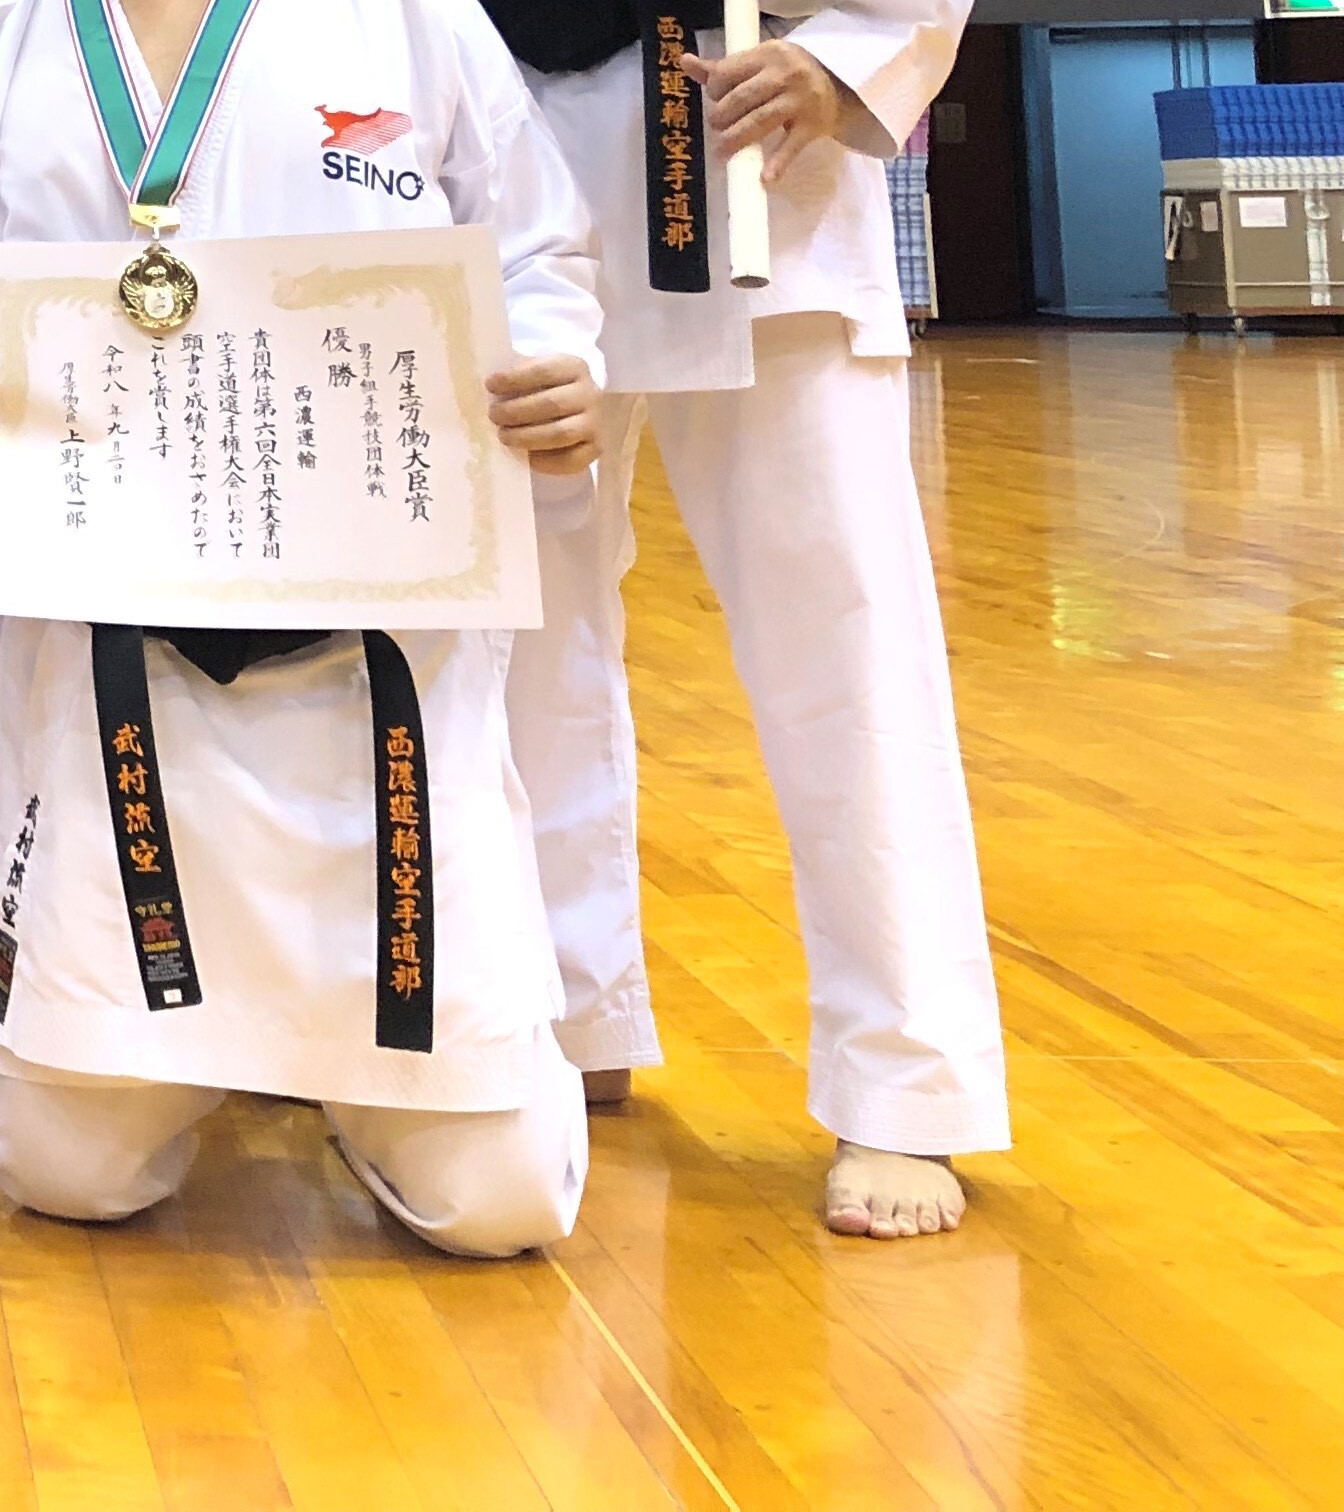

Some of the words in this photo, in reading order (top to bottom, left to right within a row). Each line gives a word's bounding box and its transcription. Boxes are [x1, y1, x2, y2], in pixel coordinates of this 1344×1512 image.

[322, 150, 426, 201] SEINO
[322, 326, 358, 389] 優勝
[293, 384, 318, 471] 西濃運輸
[388, 349, 434, 523] 厚生労働大臣賞
